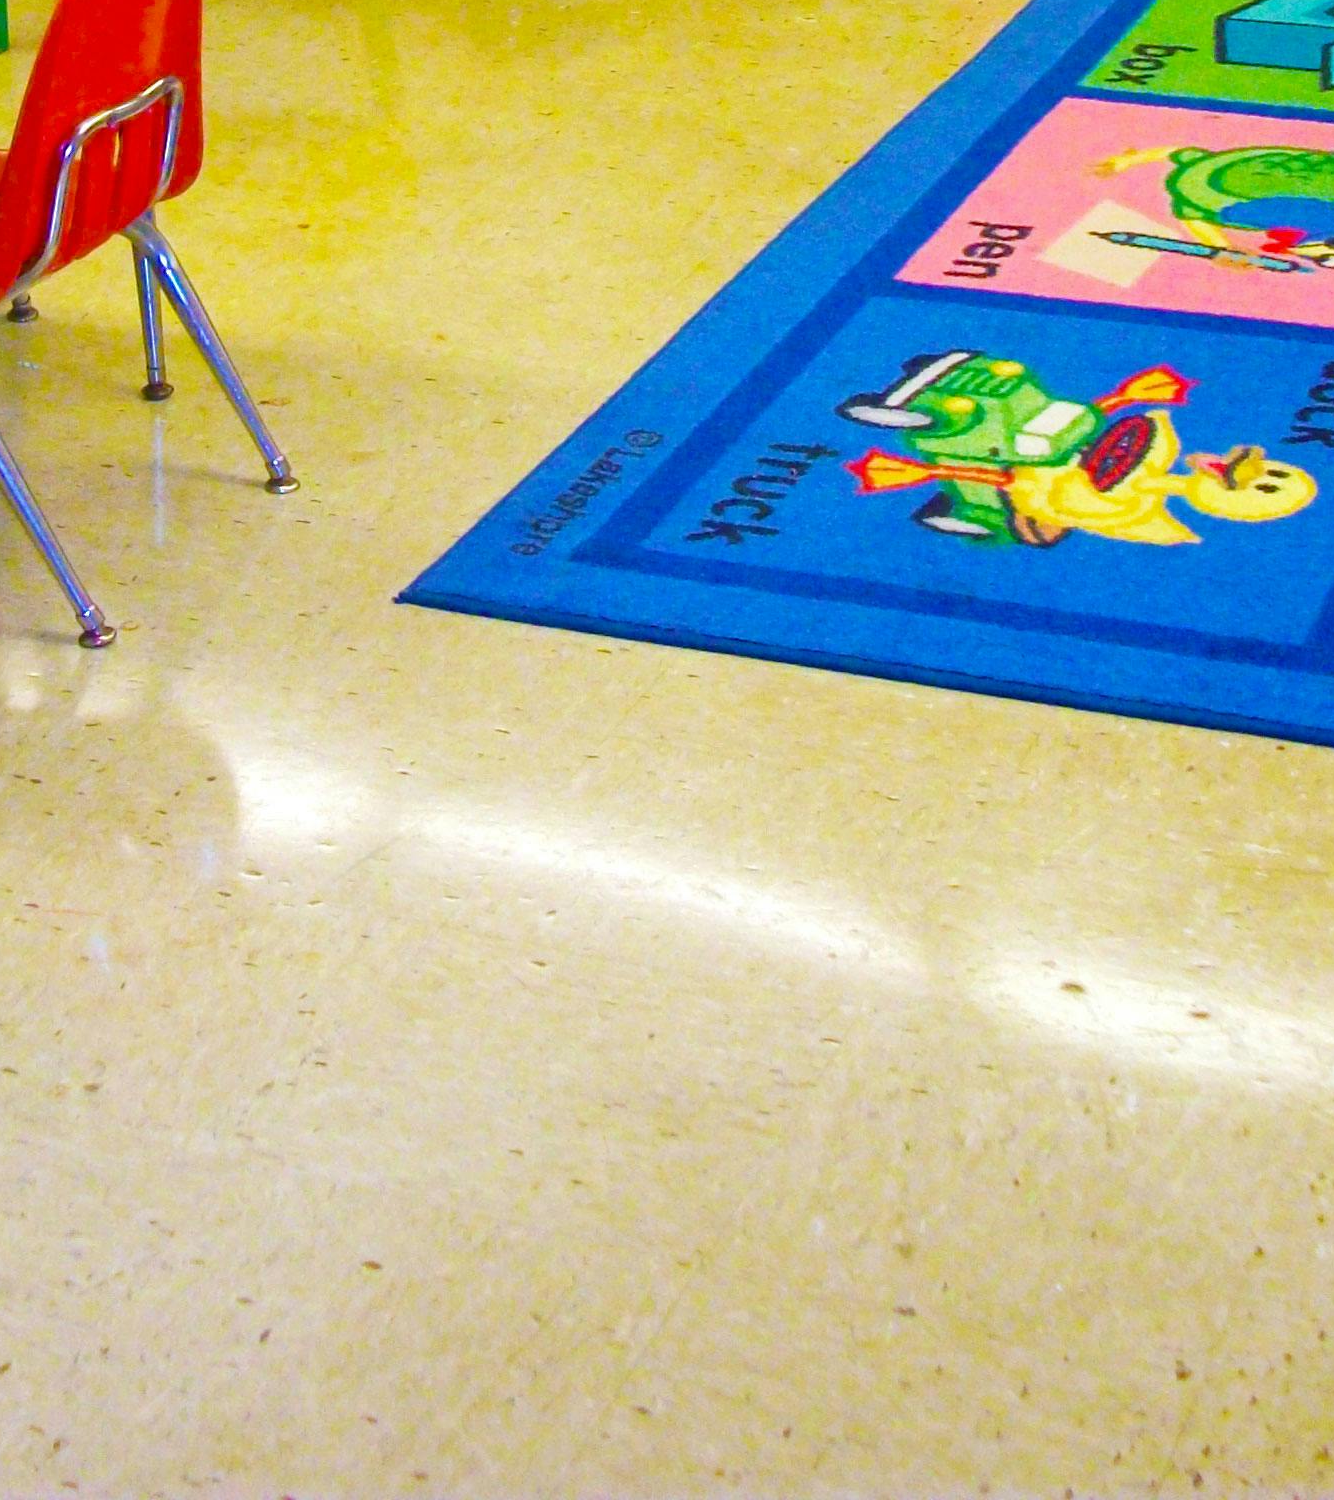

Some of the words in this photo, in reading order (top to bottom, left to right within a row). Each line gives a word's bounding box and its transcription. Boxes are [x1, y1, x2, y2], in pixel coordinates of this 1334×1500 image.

[1105, 43, 1198, 86] box
[942, 218, 1034, 281] pen
[683, 441, 841, 546] truck
